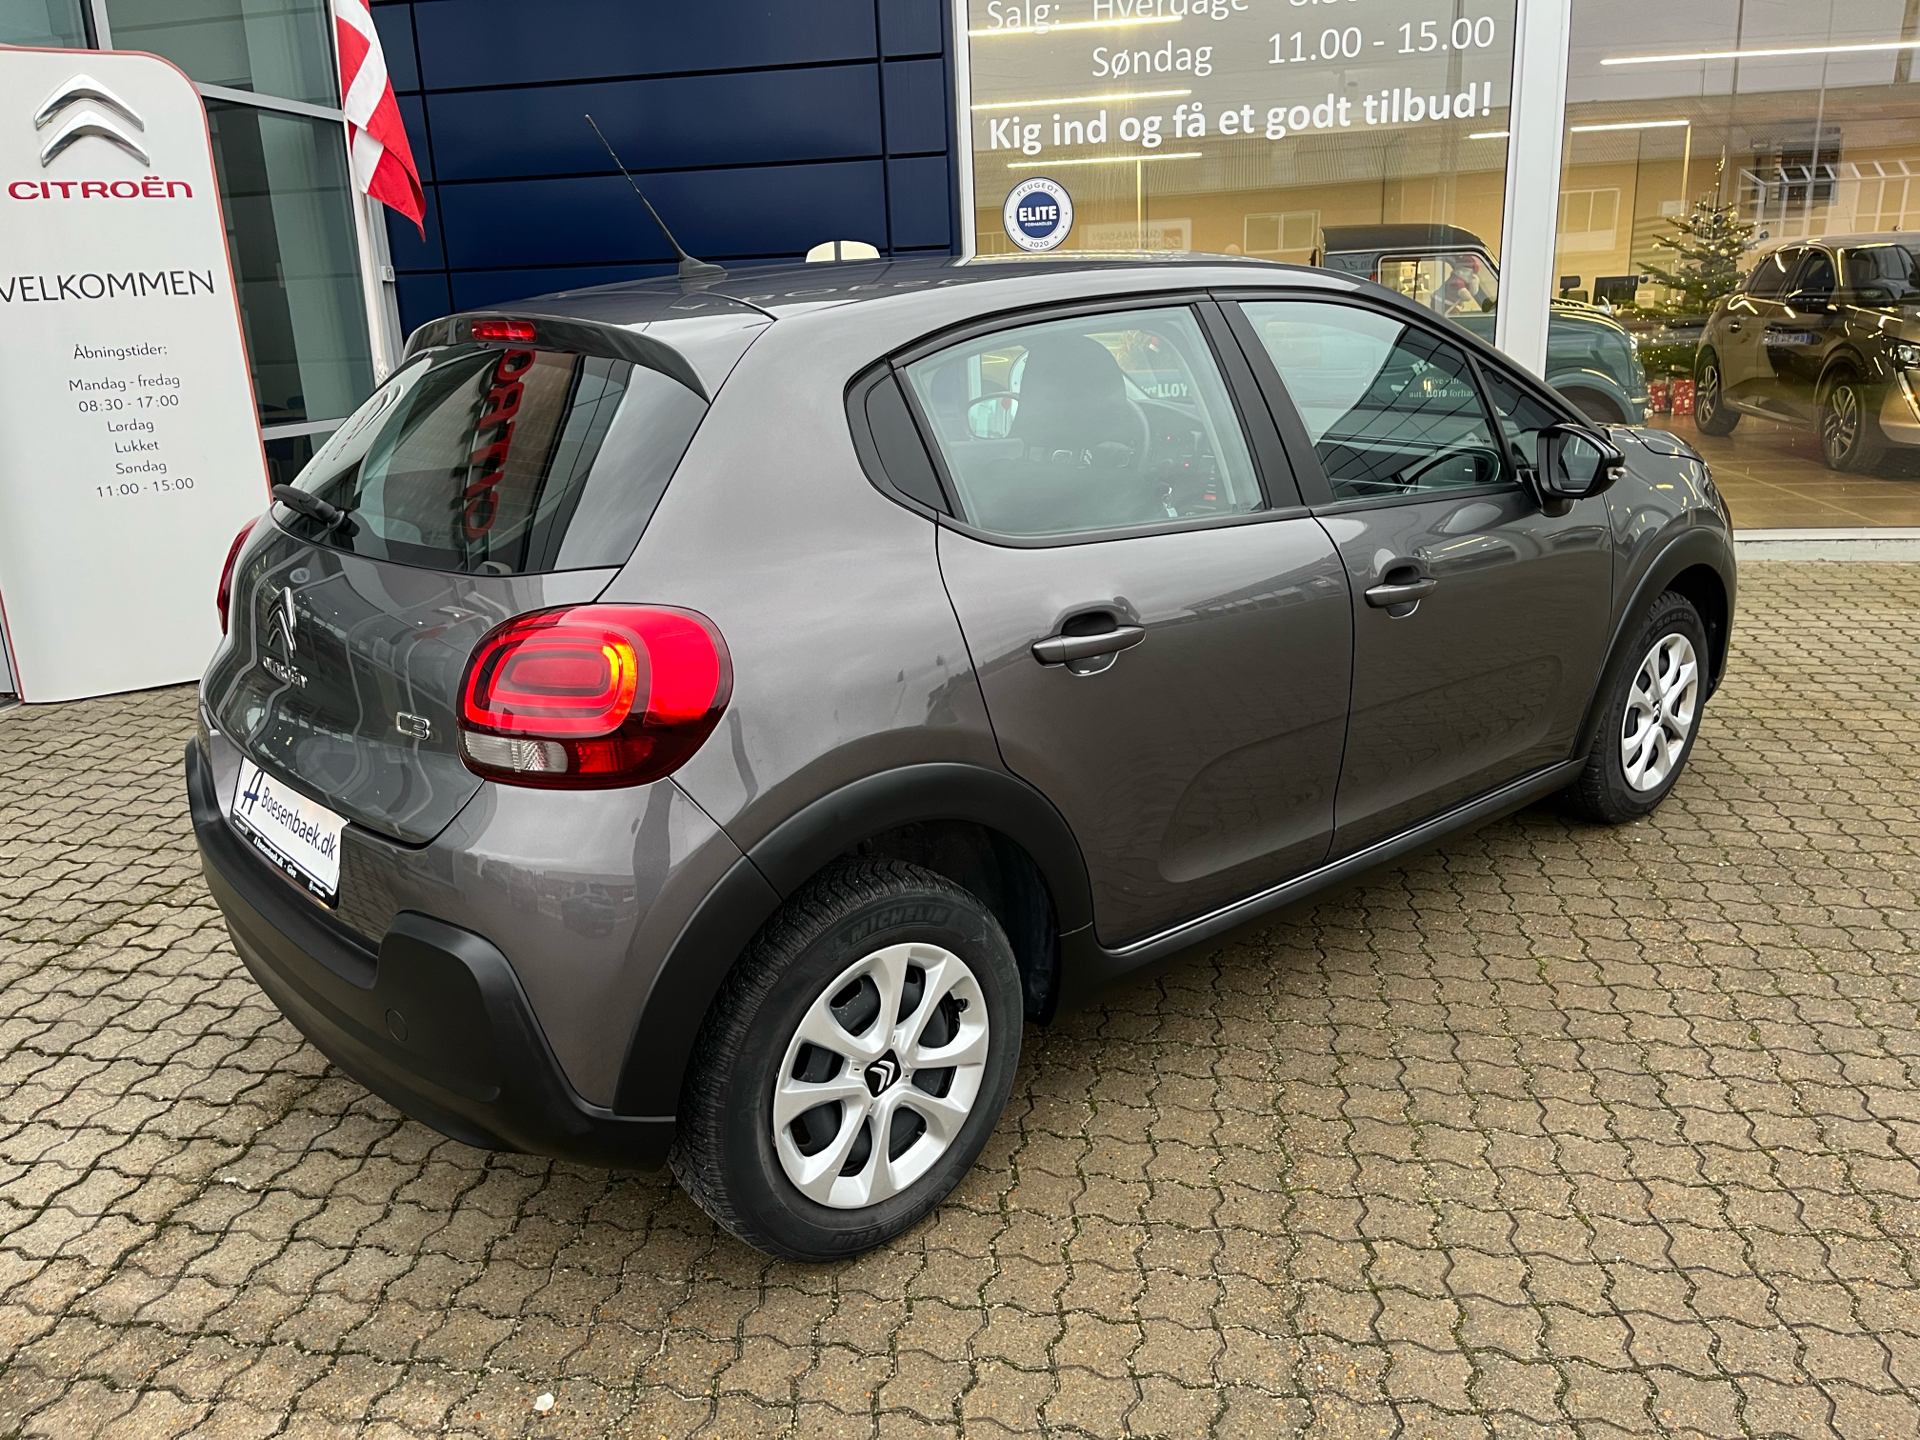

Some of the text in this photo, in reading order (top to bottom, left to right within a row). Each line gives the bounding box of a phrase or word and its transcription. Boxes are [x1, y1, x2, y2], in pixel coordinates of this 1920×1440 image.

[987, 0, 1060, 34] Salg:
[1092, 40, 1213, 78] Søndag
[1268, 27, 1362, 64] 11.00
[1398, 16, 1495, 53] 15.00
[990, 82, 1491, 155] Kig ind og få et godt tilbud!
[1016, 182, 1059, 197] PEUGEOT
[1019, 206, 1057, 222] ELITE
[1029, 240, 1050, 248] 2020
[0, 269, 215, 303] VELKOMMEN
[73, 342, 168, 361] Åbningstider:
[69, 377, 127, 392] Mandag
[137, 373, 181, 388] fredag
[1157, 383, 1192, 398] LLOY
[78, 398, 123, 413] 08:30
[136, 394, 179, 408] 17:00
[107, 418, 154, 433] Lørdag
[114, 439, 160, 454] Lukket
[115, 460, 168, 475] Søndag
[96, 483, 139, 497] 11:00
[152, 477, 194, 492] 15:00
[396, 711, 431, 740] C3
[261, 787, 337, 861] Boesenbaek.dk
[851, 907, 946, 943] MICHELIN
